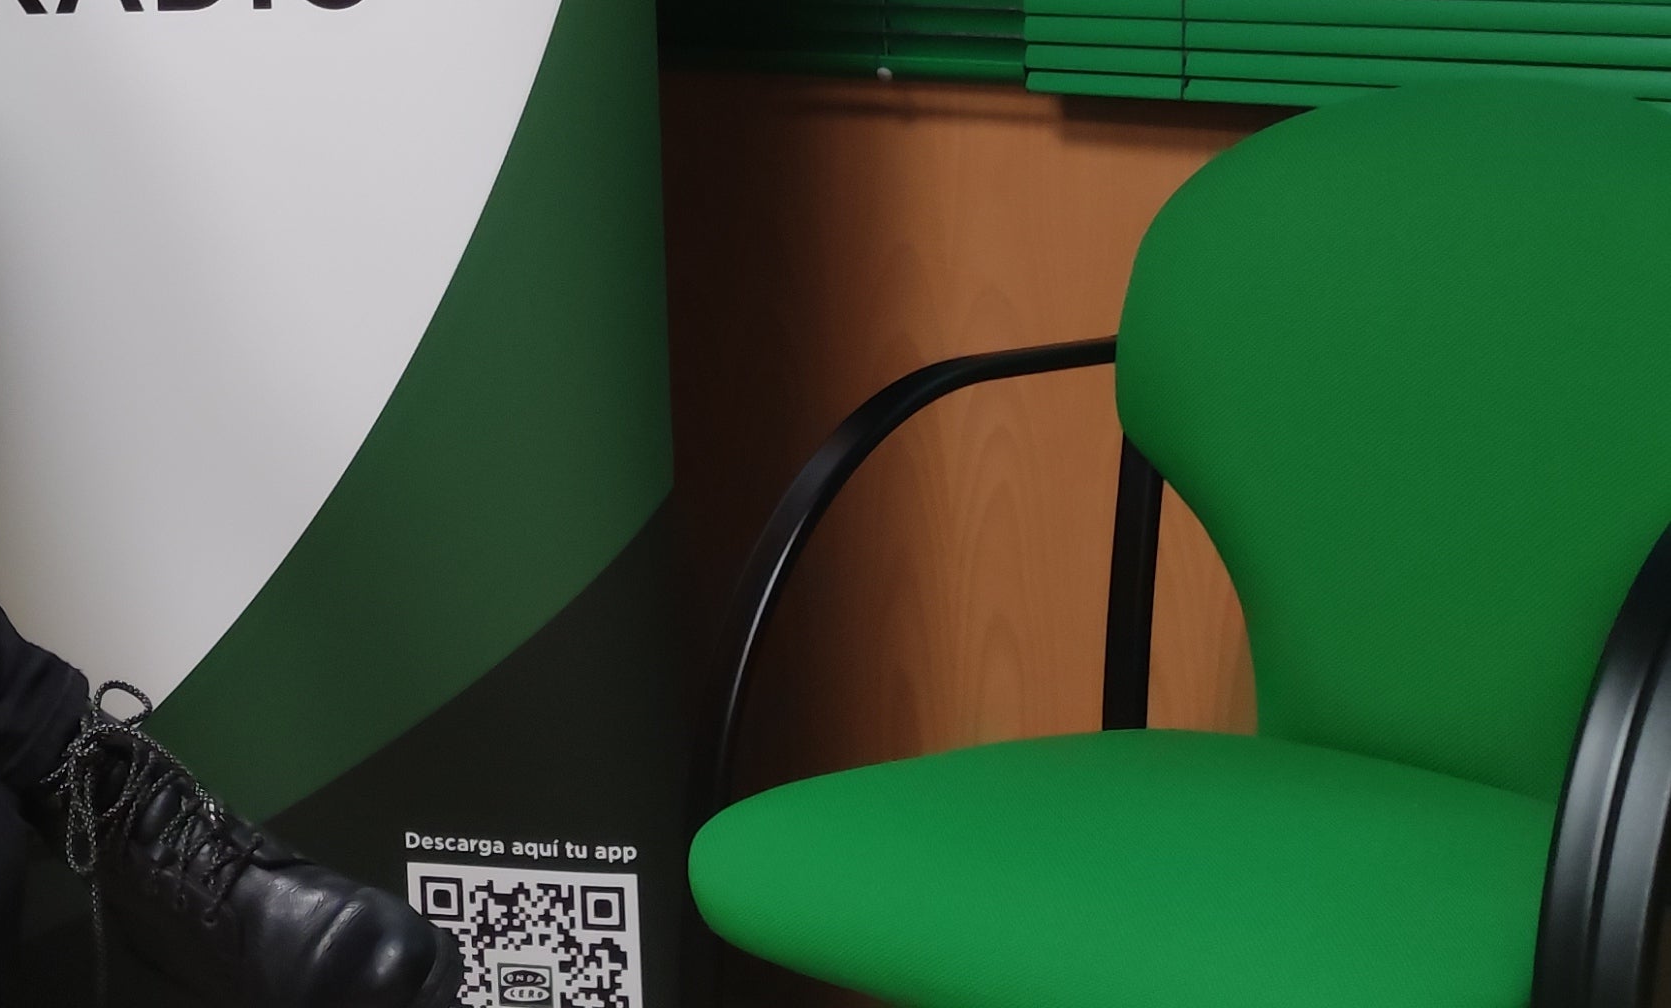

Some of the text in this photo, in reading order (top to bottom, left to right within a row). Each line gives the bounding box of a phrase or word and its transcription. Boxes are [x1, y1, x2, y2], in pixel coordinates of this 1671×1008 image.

[405, 831, 638, 864] Descarga aquí tu app
[506, 973, 544, 983] ONDA
[510, 989, 544, 999] CERO
